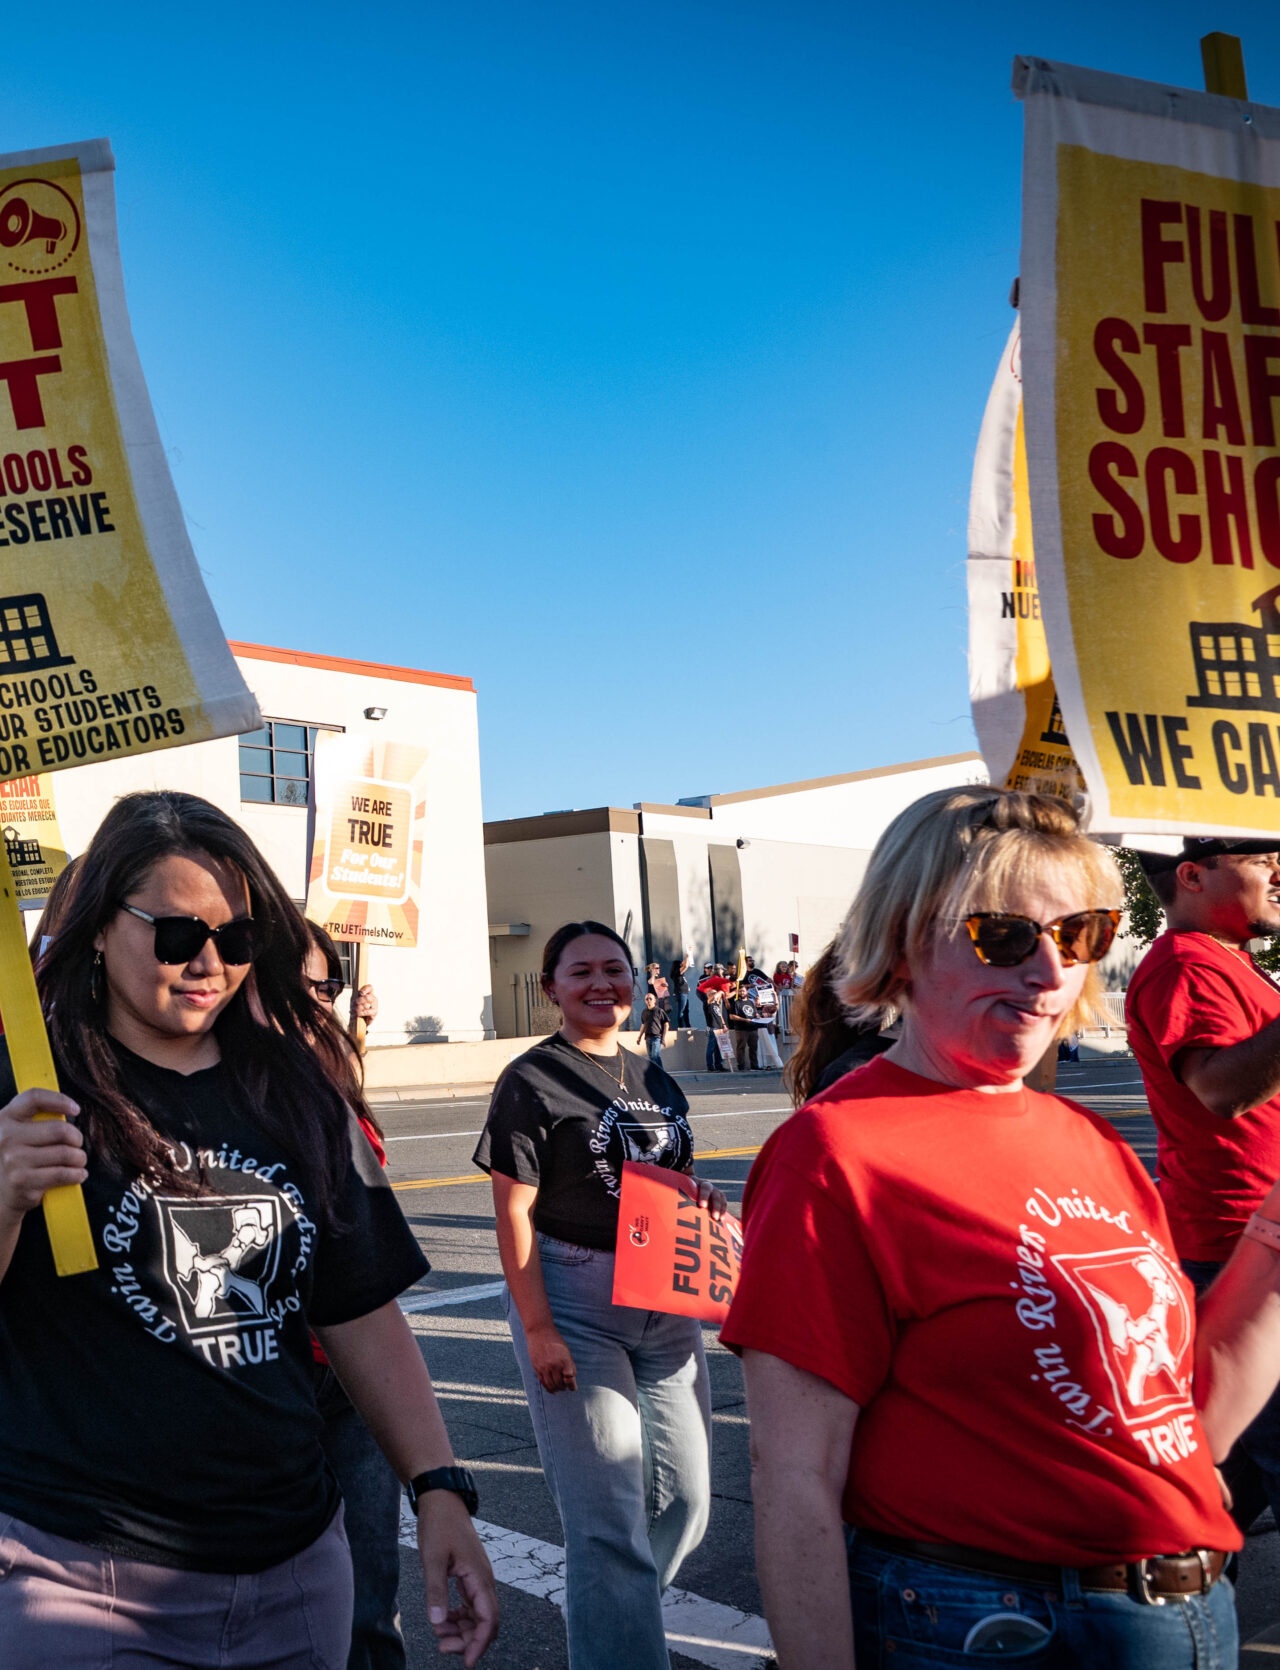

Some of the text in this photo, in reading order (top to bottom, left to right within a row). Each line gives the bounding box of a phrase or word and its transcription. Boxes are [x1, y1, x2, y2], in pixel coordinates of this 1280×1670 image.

[1141, 198, 1280, 328] FUL
[34, 685, 162, 733] STUDENTS
[36, 707, 185, 766] EDUCATORS
[1104, 711, 1280, 798] WE CA
[9, 799, 38, 811] ESCUELAS
[39, 799, 51, 810] QUE
[28, 810, 57, 822] MERECEN
[351, 796, 392, 816] WE ARE
[347, 818, 394, 849] TRUE
[330, 866, 404, 889] Students!
[340, 848, 398, 870] For Our
[322, 921, 404, 940] #TRUETimeIsNow
[589, 1107, 618, 1154] Rivers
[613, 1096, 672, 1117] United
[111, 1262, 177, 1344] Twin
[168, 1141, 286, 1184] United
[673, 1187, 703, 1296] FULLY
[709, 1220, 733, 1306] STAF
[1010, 1187, 1132, 1438] Twin Rivers United
[192, 1329, 279, 1368] TRUE
[1132, 1414, 1198, 1466] TRUE
